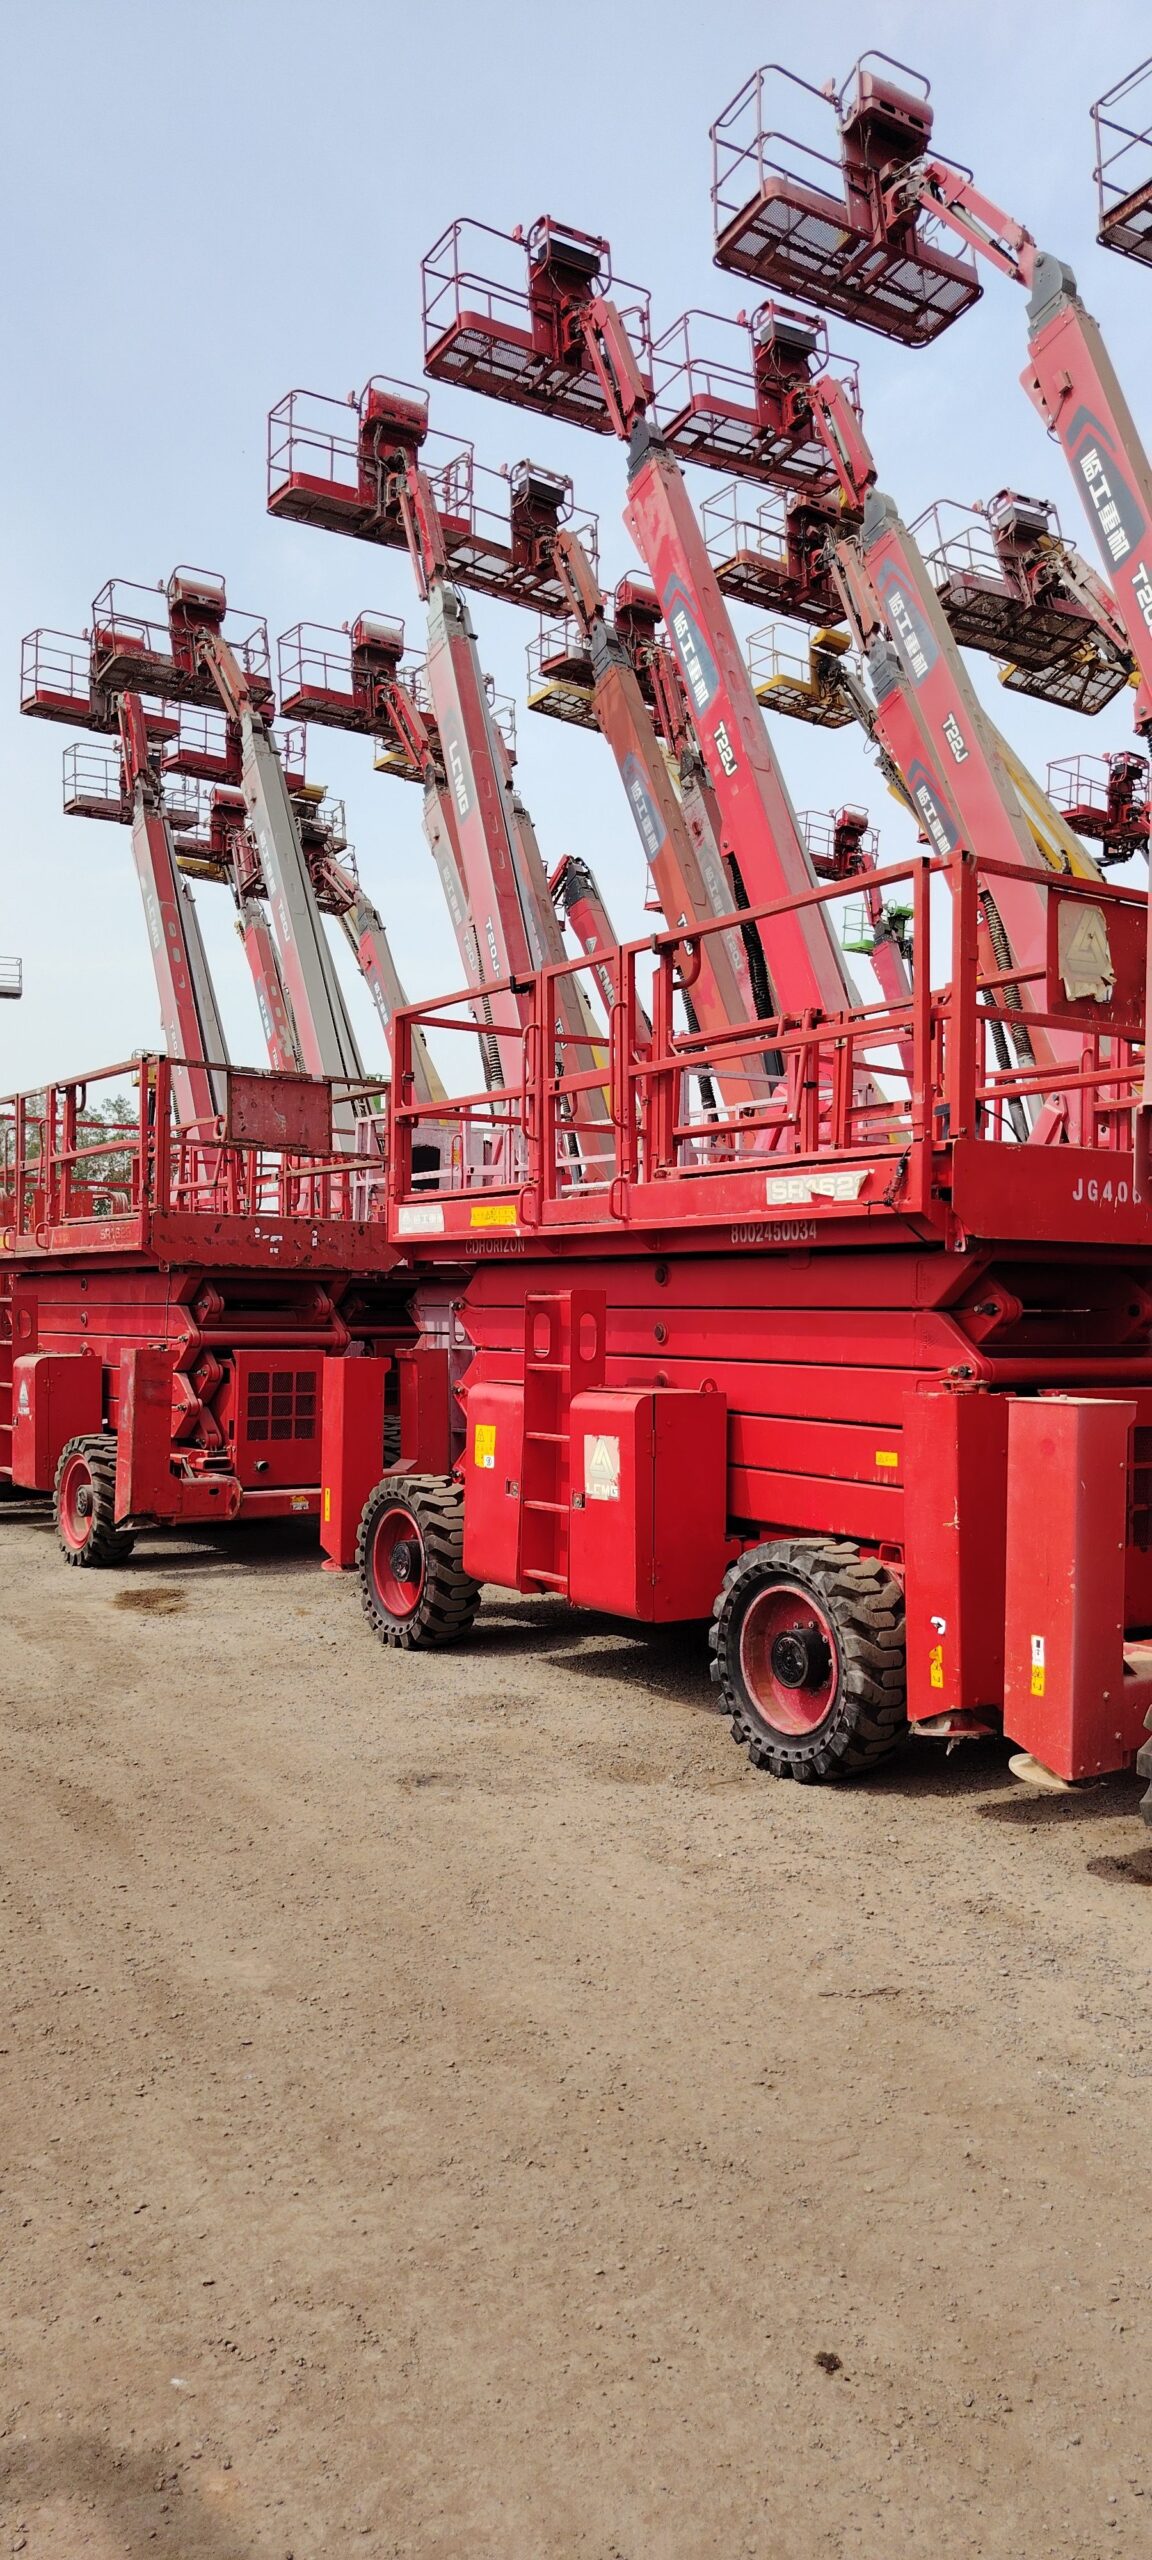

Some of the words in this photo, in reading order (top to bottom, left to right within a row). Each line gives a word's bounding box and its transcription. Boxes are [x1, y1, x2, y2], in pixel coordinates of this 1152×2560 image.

[1080, 448, 1130, 562] 临工重机
[673, 610, 710, 708] 临工重机
[889, 591, 928, 678] 临工重机
[713, 721, 737, 777] T22J
[943, 713, 968, 763] T22J
[449, 740, 469, 815] LCMG
[730, 1220, 817, 1244] 8002450034
